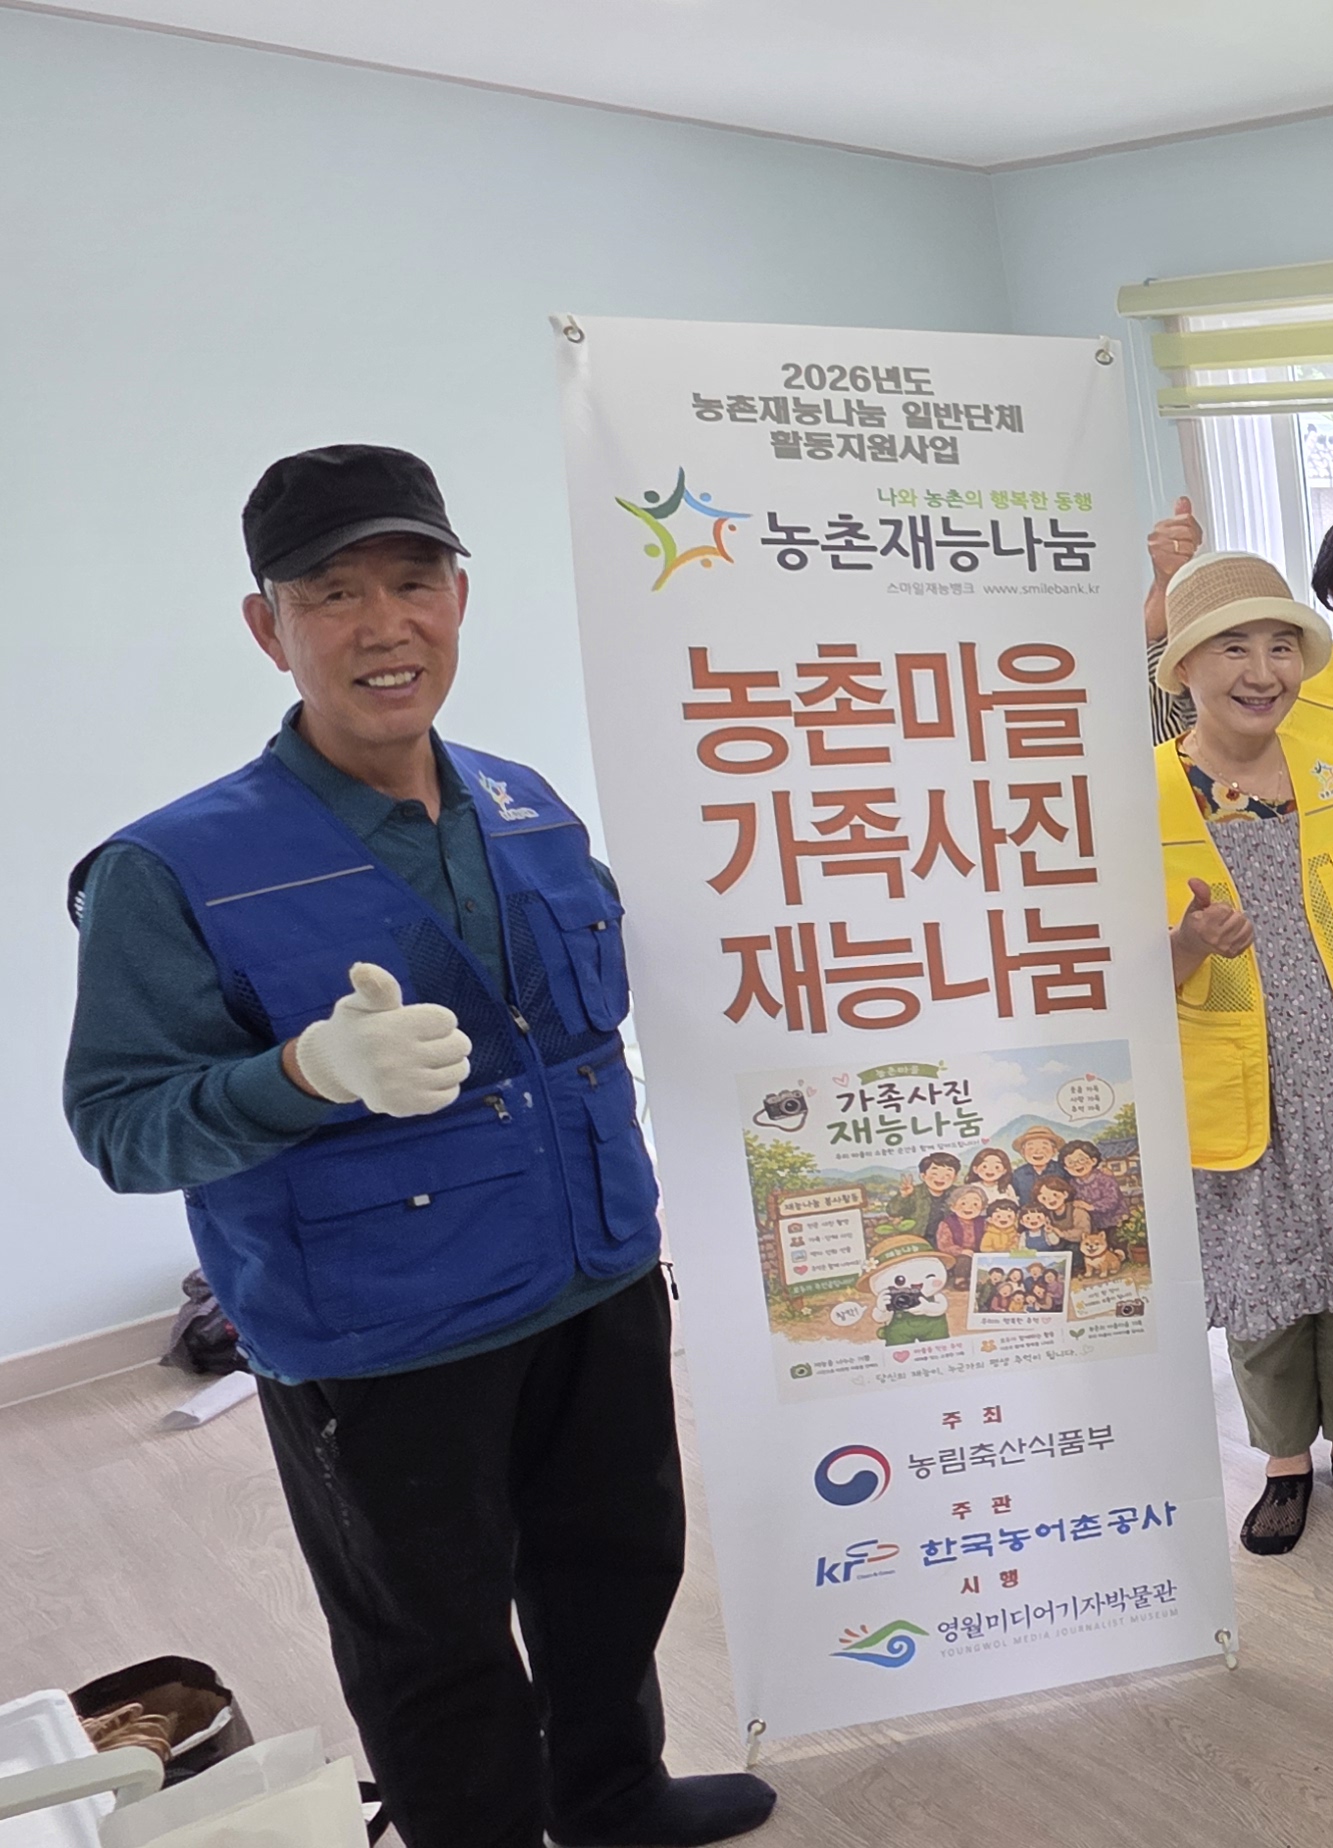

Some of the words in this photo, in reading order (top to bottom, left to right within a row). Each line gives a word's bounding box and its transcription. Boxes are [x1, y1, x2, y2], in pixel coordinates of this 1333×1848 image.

[781, 362, 935, 396] 2026년도
[691, 392, 887, 428] 농촌재능나눔
[901, 400, 1024, 434] 일반단체
[770, 430, 960, 465] 활동지원사업
[877, 488, 918, 507] 나와
[924, 489, 983, 508] 농촌의
[989, 489, 1049, 511] 행복한
[1054, 491, 1093, 512] 동행
[760, 512, 1097, 572] 농촌재능나눔
[886, 582, 975, 595] 스마일재능뱅크
[983, 582, 1100, 595] www.smilebank.kr
[682, 640, 1088, 776] 농촌마을
[700, 774, 1100, 906] 가족사진
[720, 907, 1112, 1035] 재능나눔
[875, 1065, 920, 1078] 농촌마을
[836, 1079, 972, 1113] 가족사진
[826, 1107, 984, 1146] 재능나눔
[876, 1373, 907, 1384] 당신의
[948, 1361, 985, 1373] 누군가의
[989, 1358, 1010, 1368] 평생
[1014, 1354, 1041, 1364] 추억이
[907, 1424, 1116, 1480] 농림축산식품부
[920, 1500, 1178, 1567] 한국농어촌공사
[816, 1557, 865, 1587] kr
[937, 1579, 1178, 1644] 영월미디어기자박물관
[940, 1639, 1008, 1658] YOUNGWOL
[1013, 1631, 1051, 1645] MEDIA
[1054, 1617, 1125, 1638] JOURNALIST
[1130, 1608, 1179, 1624] MUSEUM
